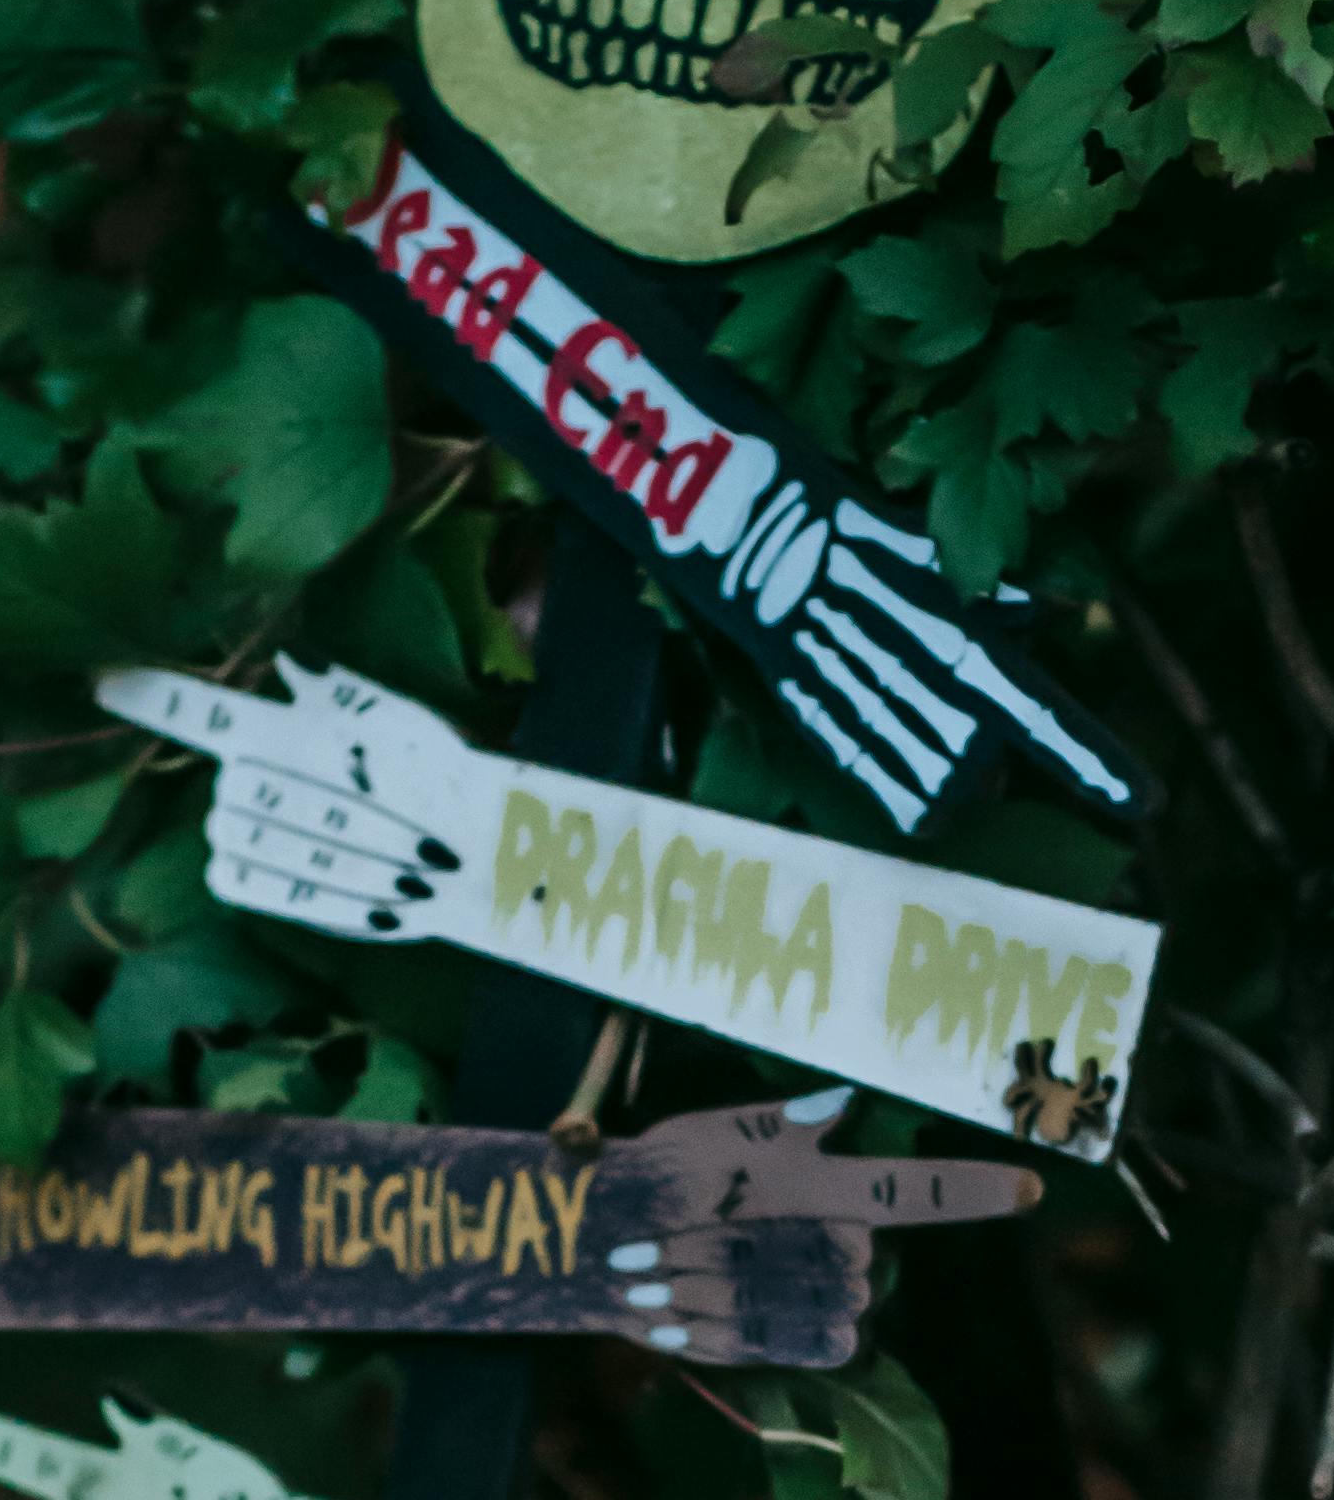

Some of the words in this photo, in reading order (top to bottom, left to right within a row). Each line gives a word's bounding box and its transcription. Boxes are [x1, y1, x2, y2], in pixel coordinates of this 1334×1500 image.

[543, 318, 734, 536] End
[491, 788, 834, 1032] DRACULA
[885, 903, 1132, 1075] DRIVE
[0, 1152, 278, 1268] HOWLING
[302, 1163, 596, 1278] HIGHWAY
